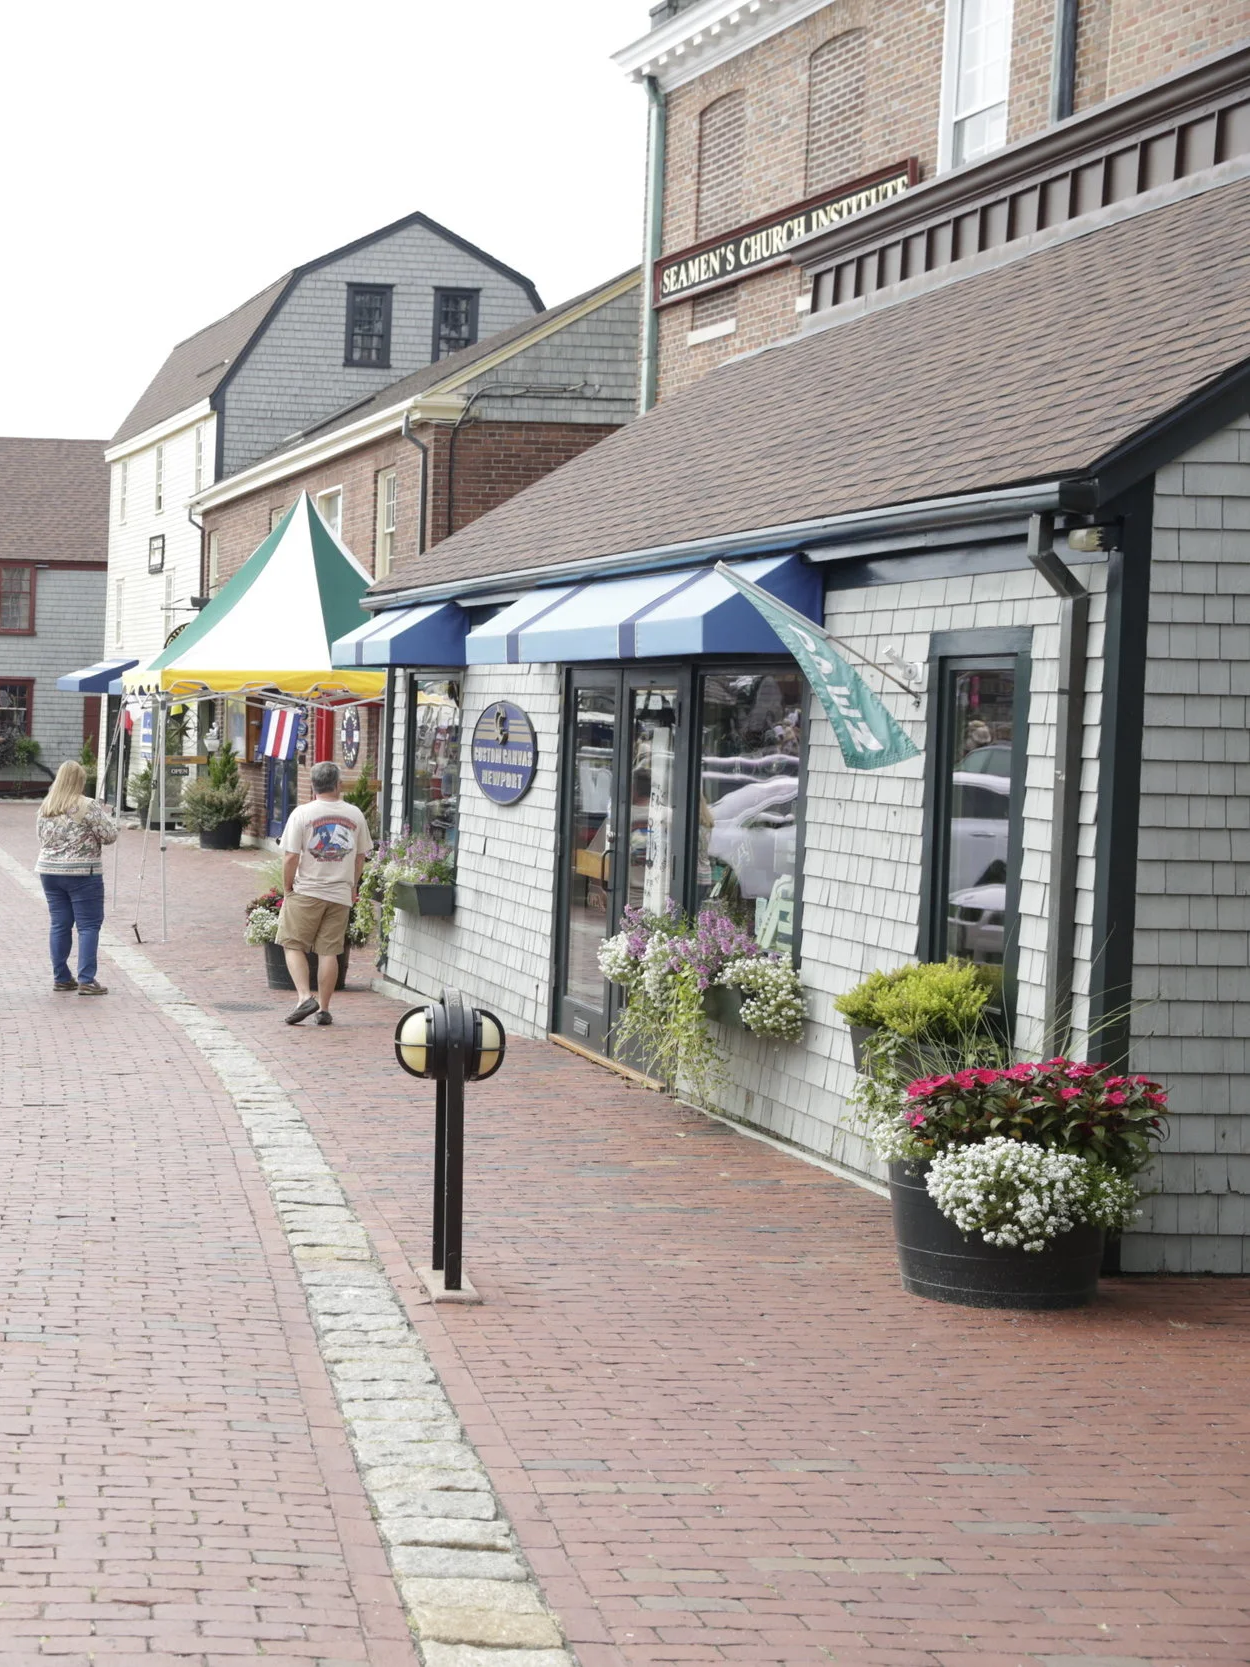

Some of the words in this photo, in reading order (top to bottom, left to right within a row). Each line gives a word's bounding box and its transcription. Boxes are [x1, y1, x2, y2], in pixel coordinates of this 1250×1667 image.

[662, 243, 735, 294] SEAMEN'S
[739, 215, 805, 266] CHURCH
[811, 174, 909, 233] INSTITUTE
[787, 623, 885, 753] OPEN
[474, 746, 502, 764] CUSTOM
[502, 748, 533, 768] CANVAS
[481, 769, 523, 789] NEWPORT
